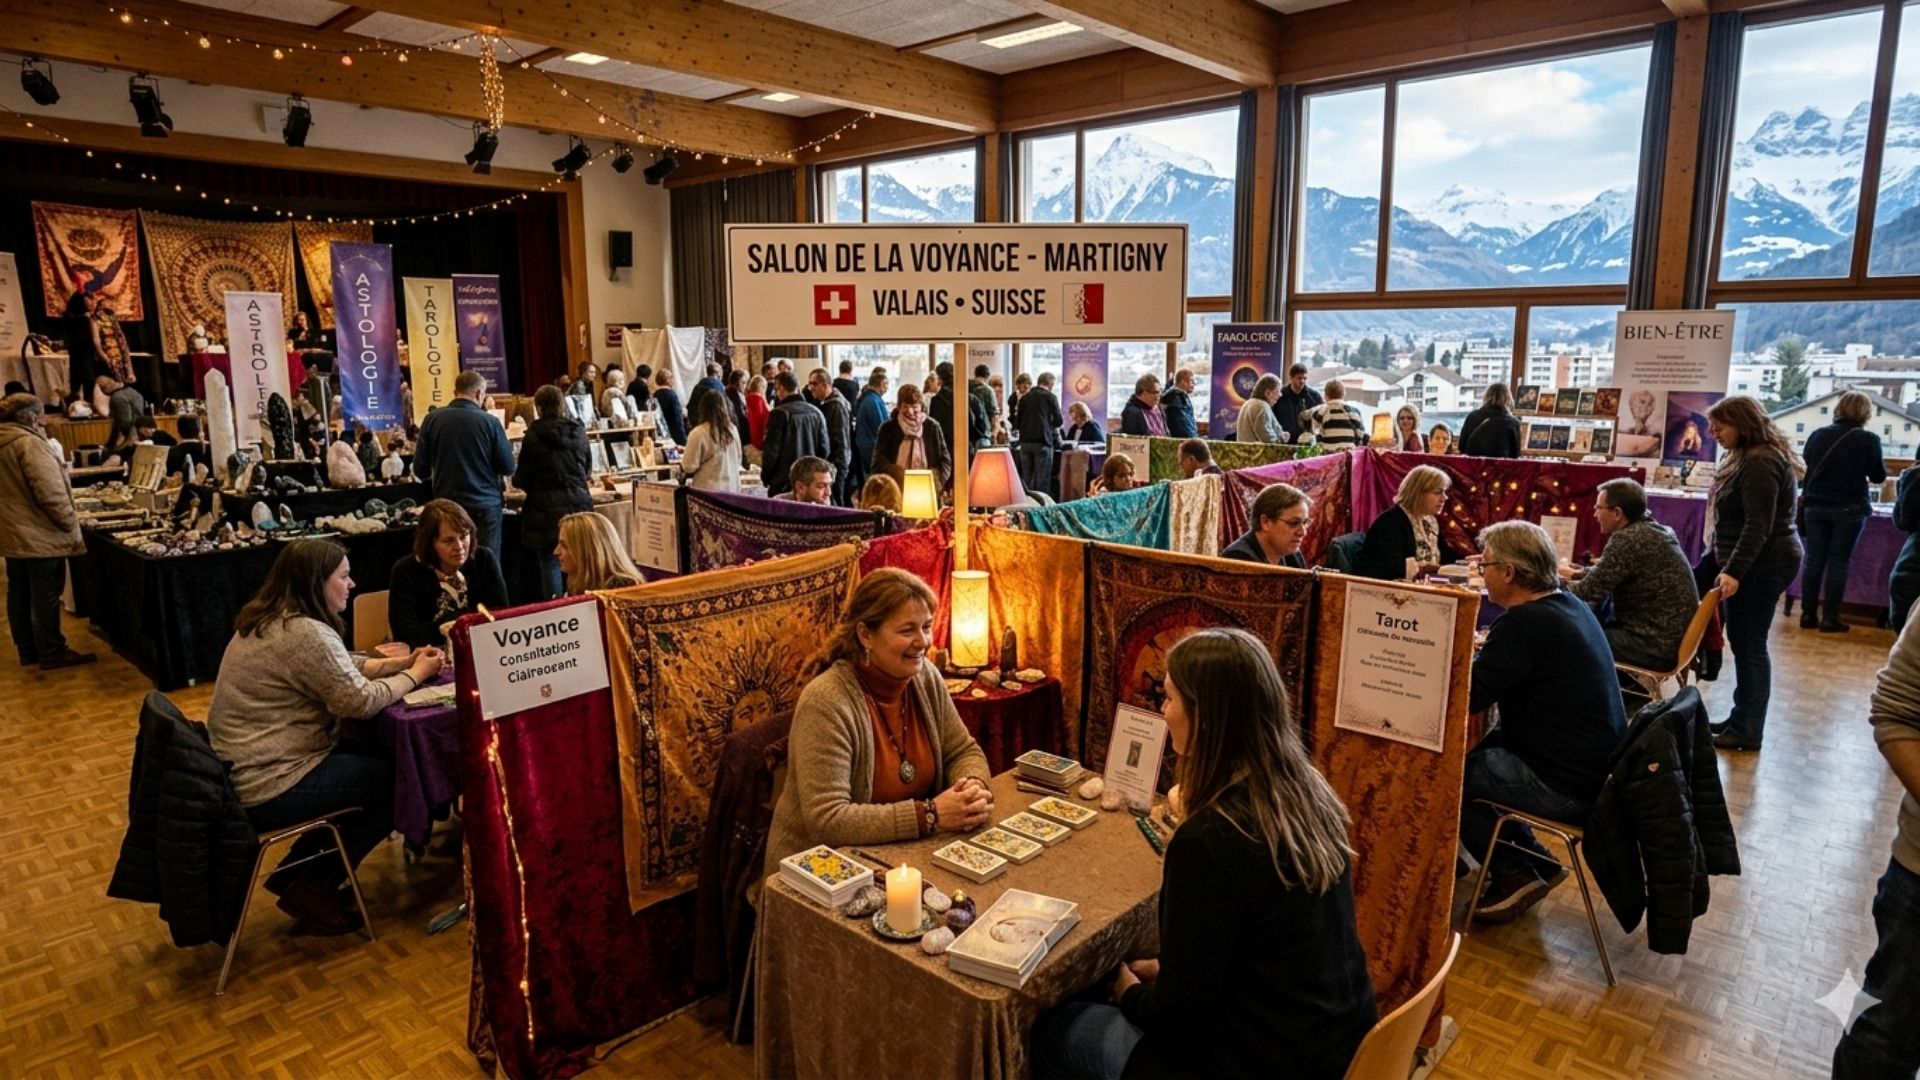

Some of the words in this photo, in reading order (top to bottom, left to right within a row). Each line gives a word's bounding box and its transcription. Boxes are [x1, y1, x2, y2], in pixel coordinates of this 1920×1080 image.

[747, 243, 827, 273] SALON
[836, 243, 866, 272] DE
[874, 243, 904, 272] LA
[910, 243, 1020, 272] VOYANCE
[1045, 243, 1169, 272] MARTIGNY
[872, 289, 949, 315] VALAIS
[972, 289, 1046, 315] SUISSE
[355, 272, 380, 410] ASTOLOGIE
[424, 285, 442, 402] TAROLOGIE
[1624, 321, 1724, 340] BIEN-ÊTRE
[493, 617, 580, 648] Voyance
[1375, 611, 1420, 632] Tarot
